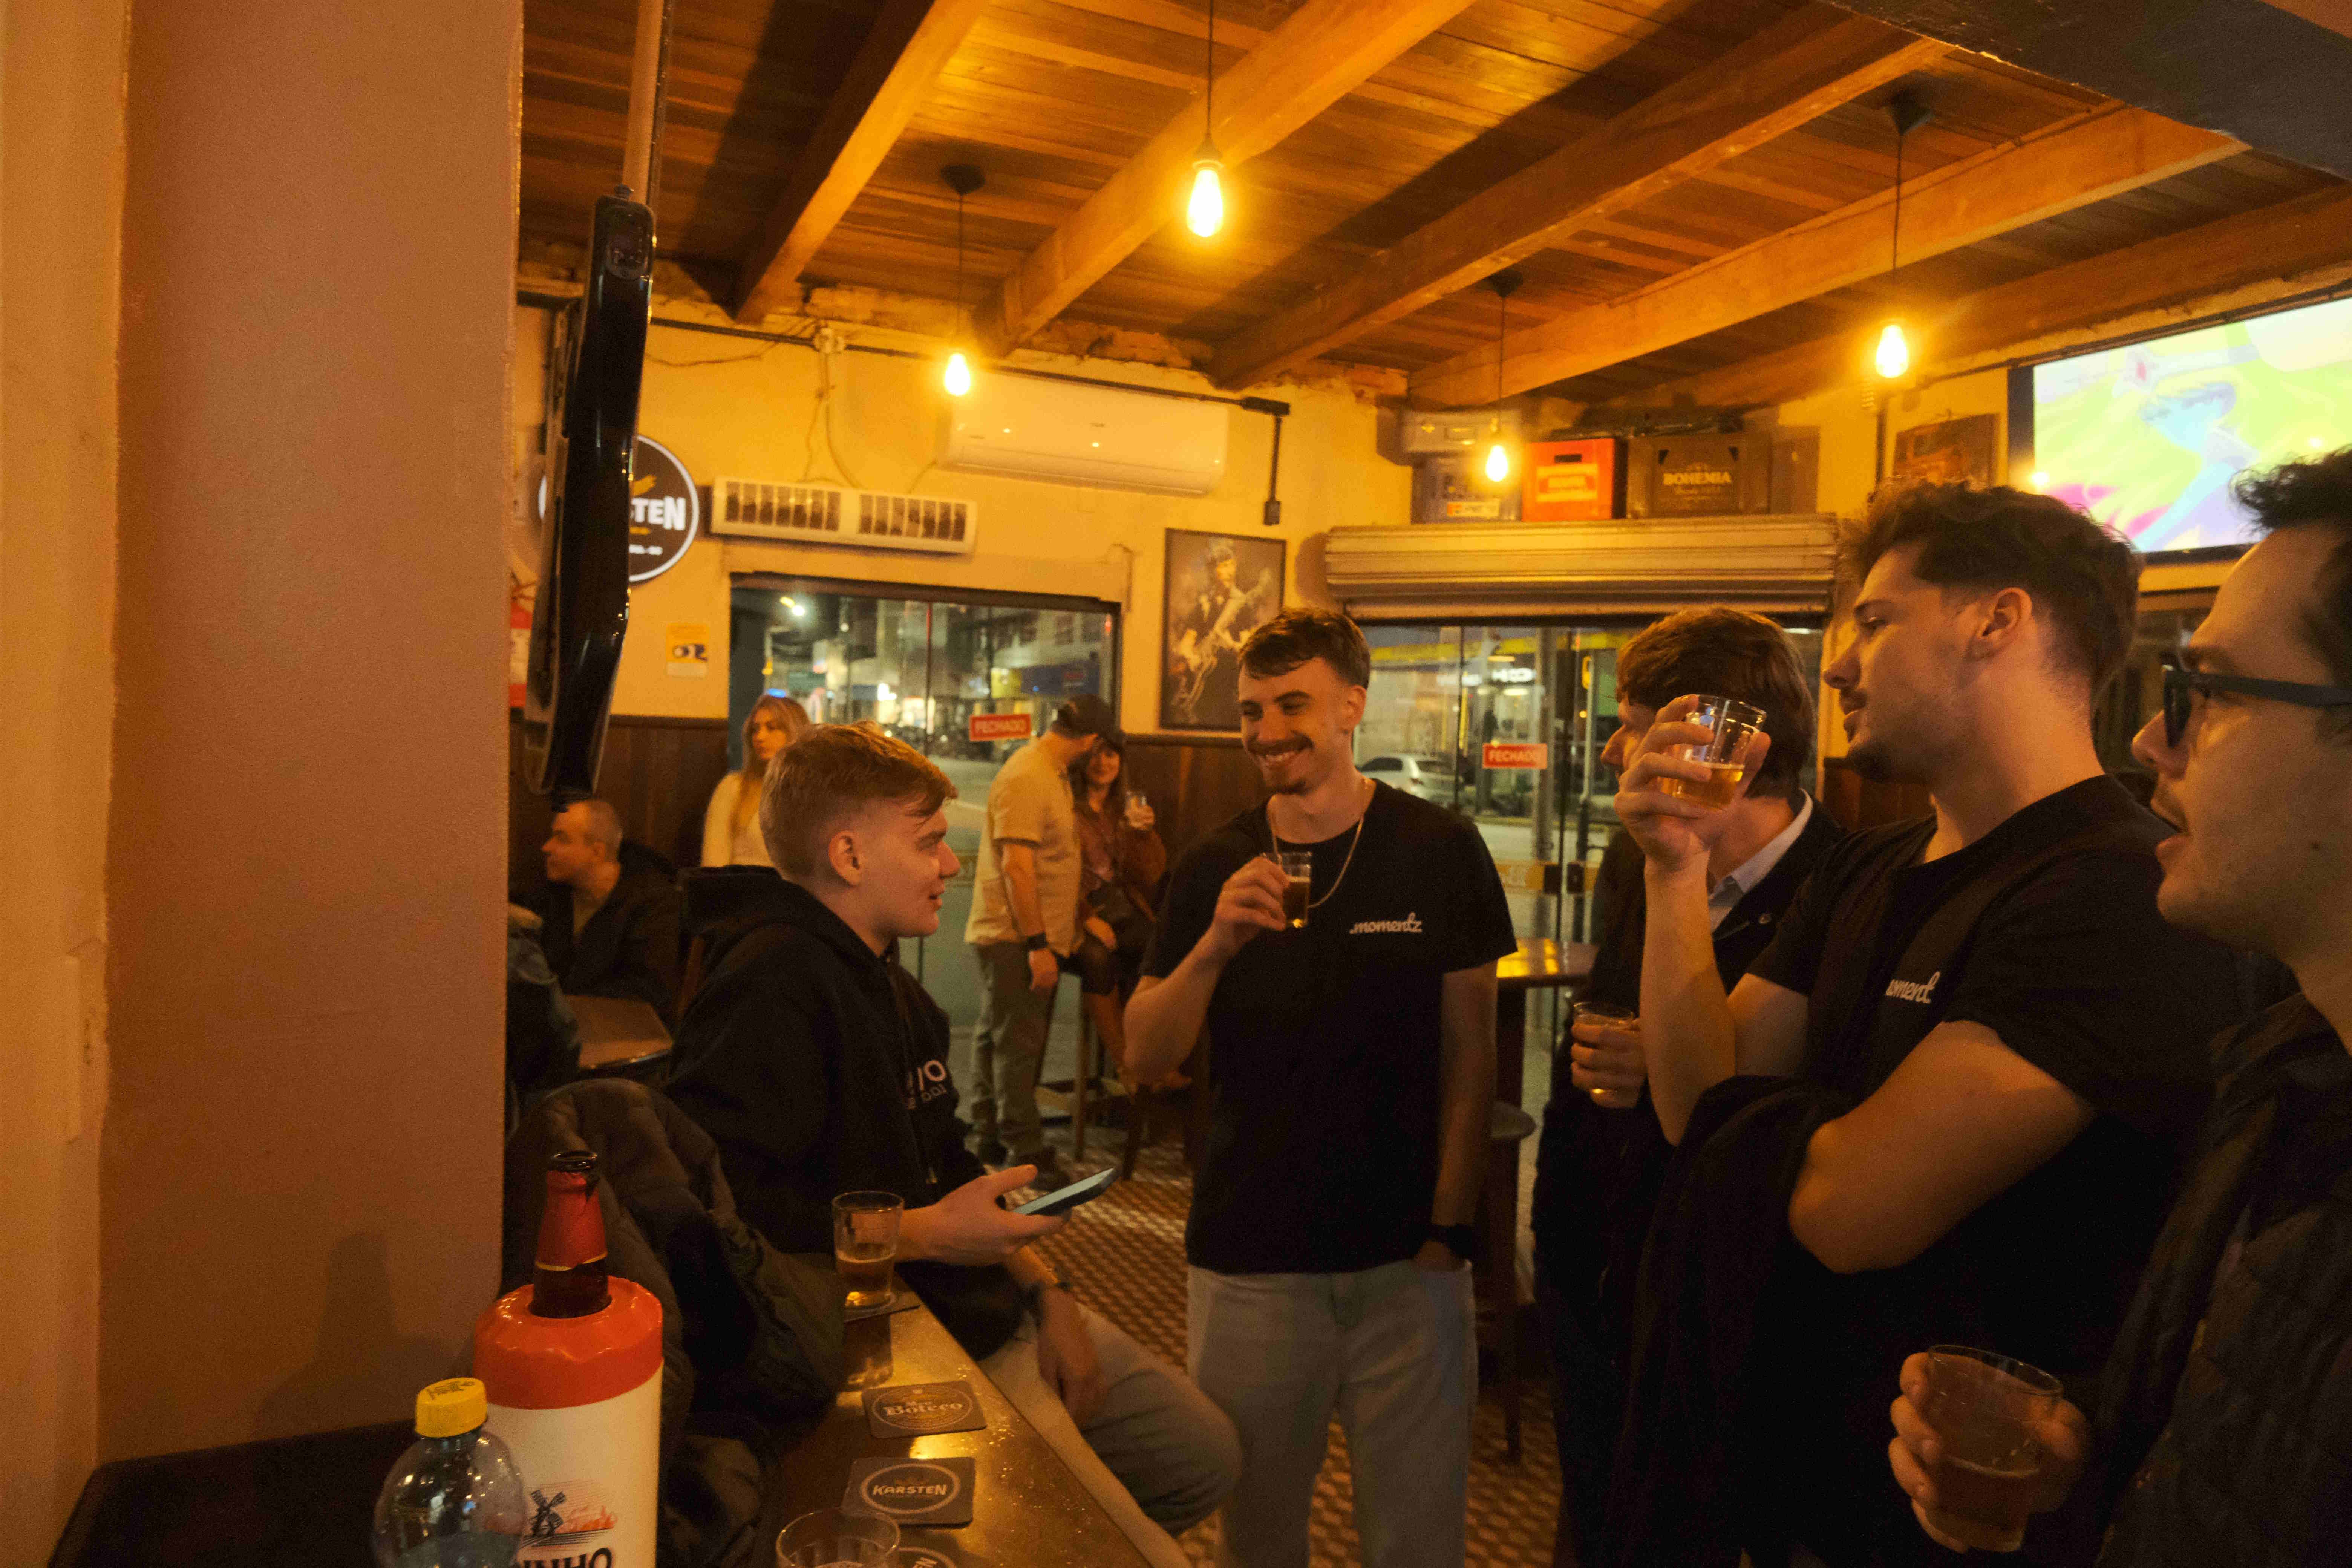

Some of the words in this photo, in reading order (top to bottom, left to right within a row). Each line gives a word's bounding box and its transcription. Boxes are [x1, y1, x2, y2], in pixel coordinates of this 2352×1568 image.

[1663, 472, 1732, 485] BOHEMIA
[631, 496, 686, 531] TEN
[883, 1403, 962, 1415] Boteco
[873, 1485, 947, 1495] KARSTEN
